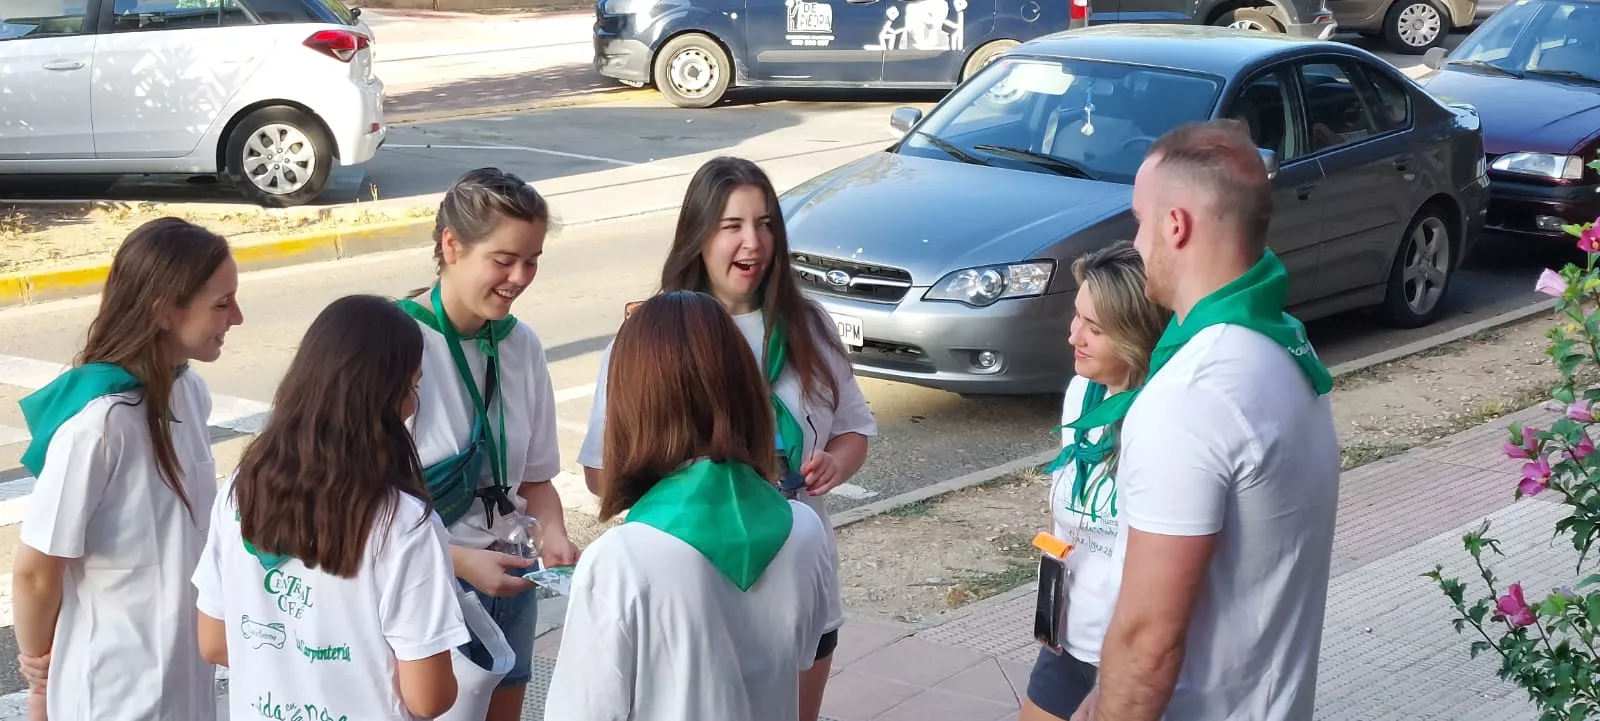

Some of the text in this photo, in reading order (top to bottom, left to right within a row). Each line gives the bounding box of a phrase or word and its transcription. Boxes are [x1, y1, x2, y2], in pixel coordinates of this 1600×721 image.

[803, 3, 817, 13] DE
[800, 14, 831, 28] PIEDRA
[263, 568, 314, 609] CENTRAL
[252, 691, 285, 721] ida
